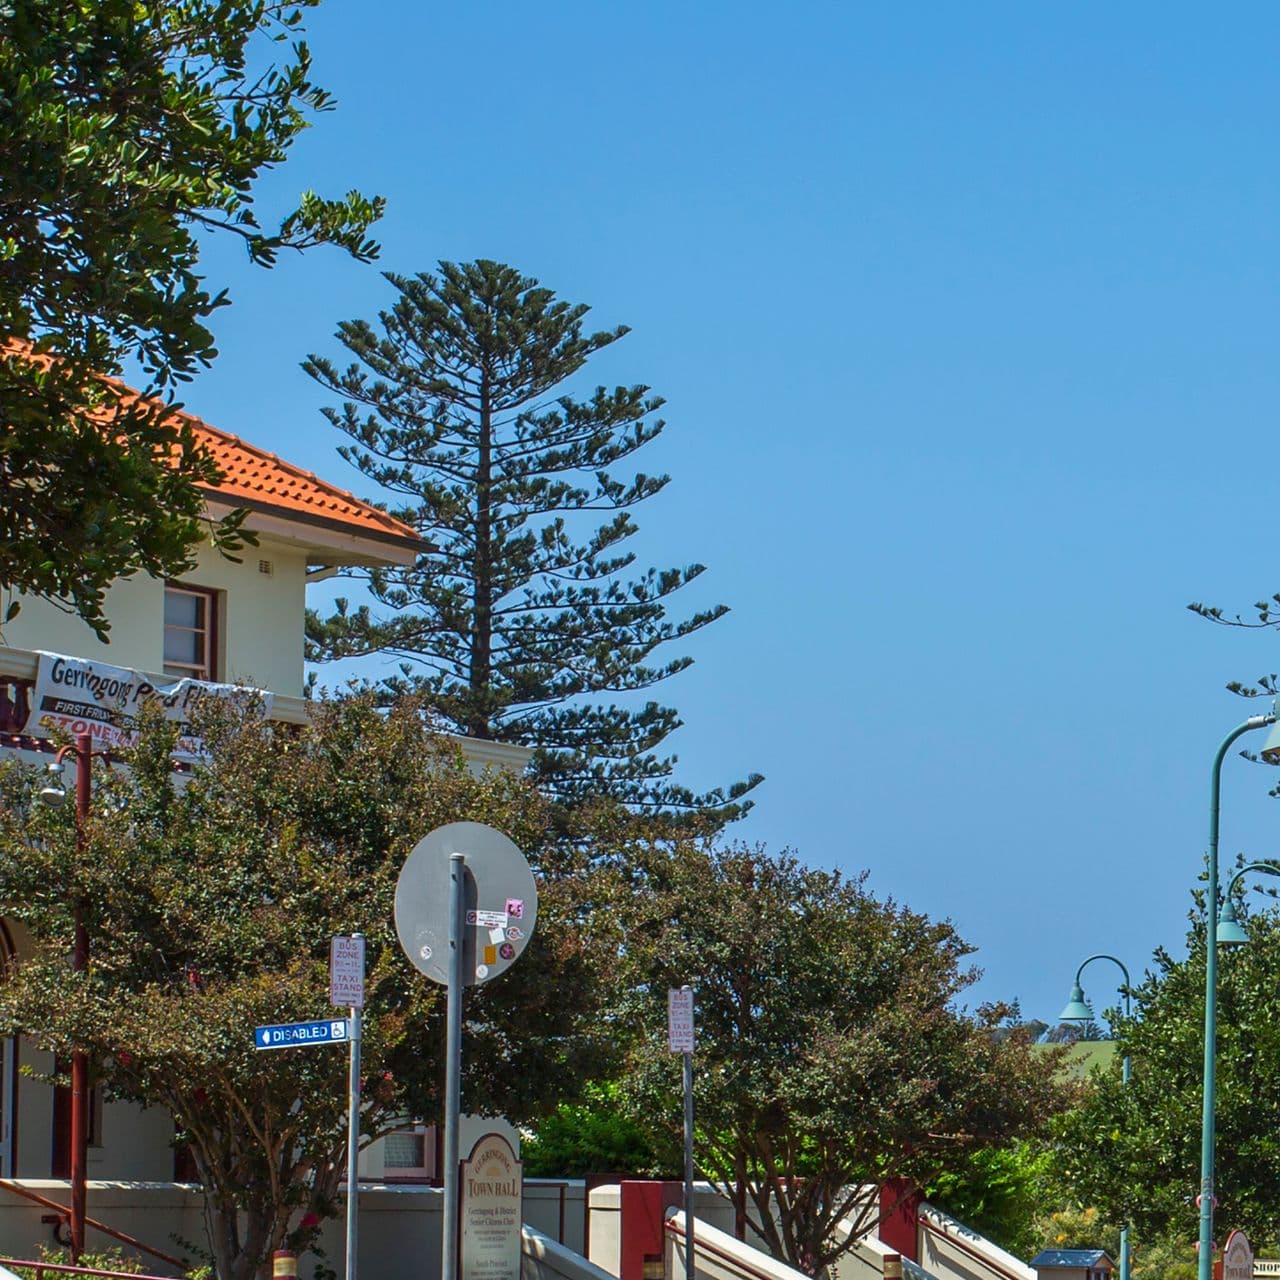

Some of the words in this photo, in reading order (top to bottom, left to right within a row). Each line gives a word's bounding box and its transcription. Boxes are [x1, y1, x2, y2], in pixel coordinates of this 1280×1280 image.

[52, 658, 134, 708] Gerringong
[55, 702, 86, 715] FIRST
[336, 951, 360, 959] ZONE
[338, 975, 359, 983] TAXI
[334, 984, 362, 992] STAND
[273, 1026, 328, 1042] DISABLED
[468, 1178, 493, 1198] TOWN
[495, 1178, 519, 1197] HALL
